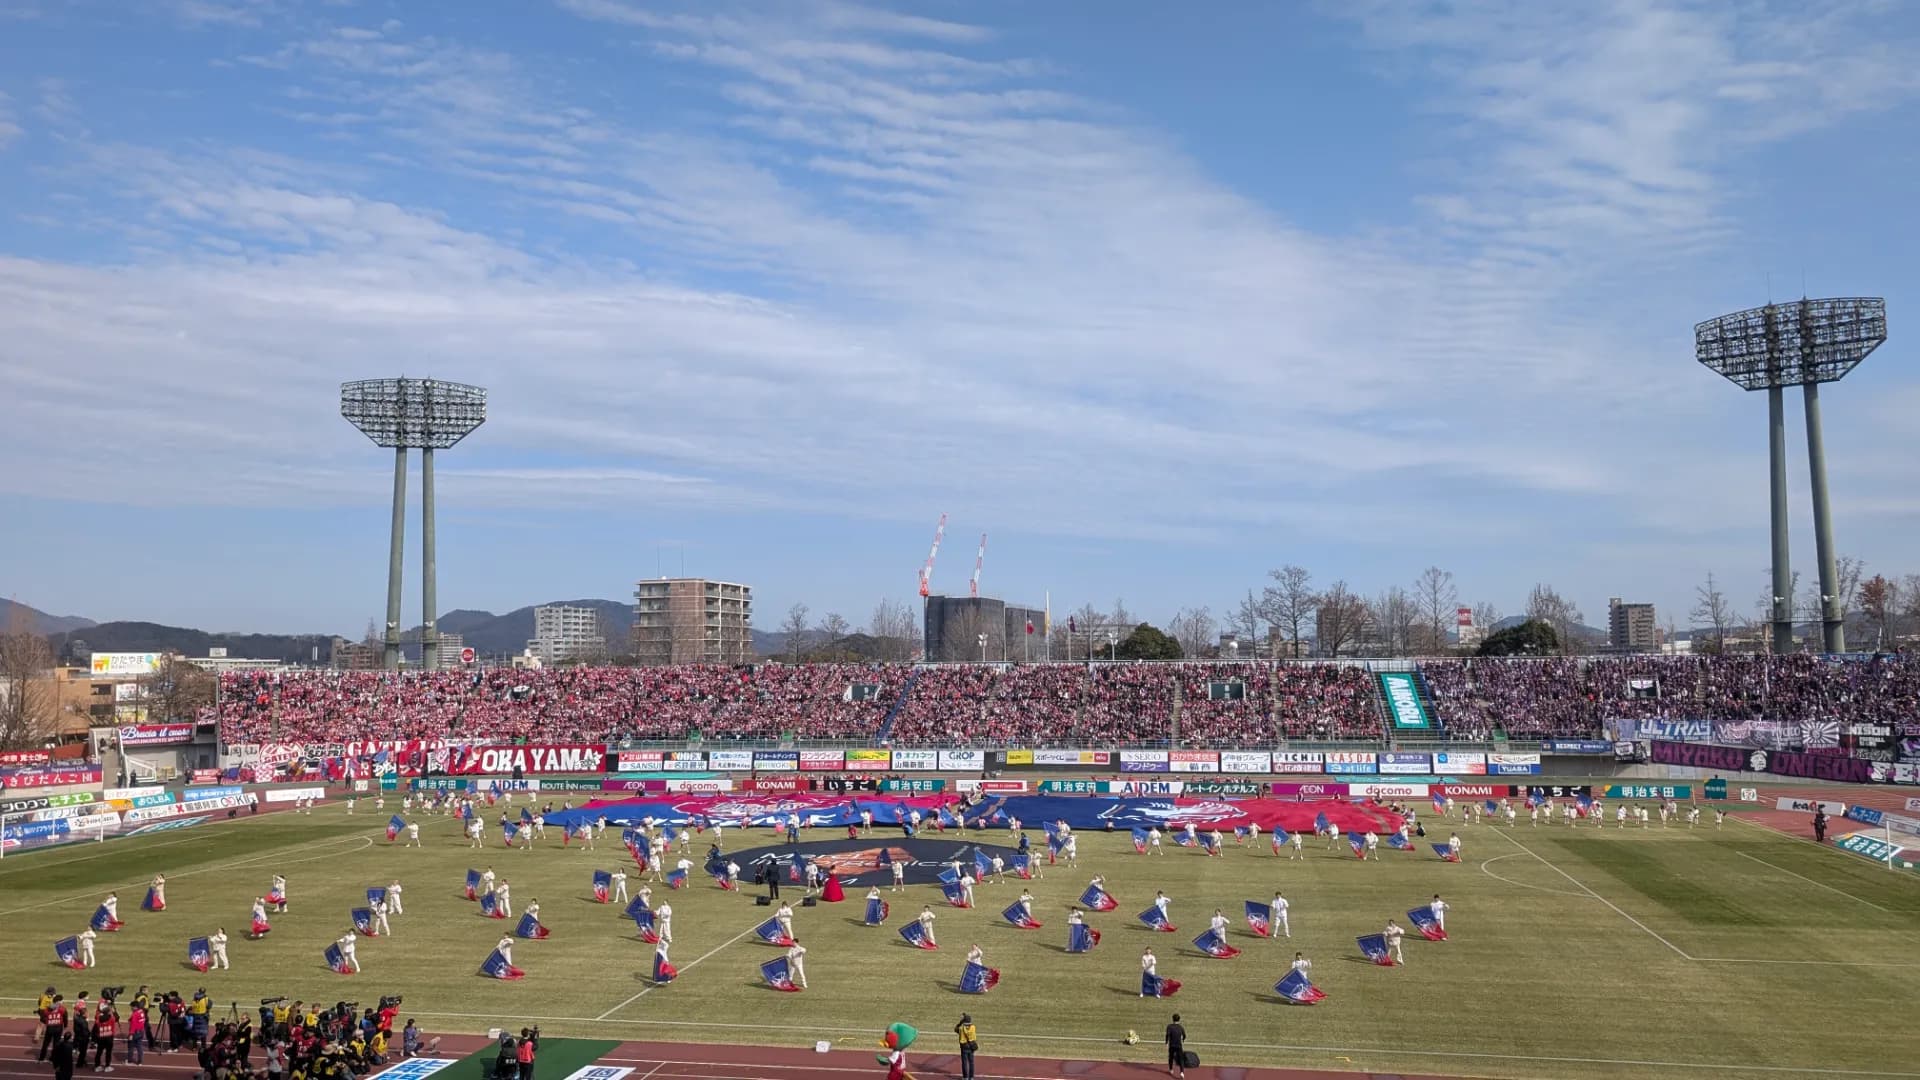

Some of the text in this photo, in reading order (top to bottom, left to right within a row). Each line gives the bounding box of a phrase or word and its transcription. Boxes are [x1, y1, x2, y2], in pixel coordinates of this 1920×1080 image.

[111, 655, 145, 665] かたやま
[1640, 719, 1712, 735] ULTRAS
[482, 748, 598, 773] OKAYAMA
[903, 752, 935, 760] オカネツ
[948, 751, 975, 760] GROP
[1330, 753, 1373, 763] YASDA
[1651, 743, 1744, 769] MIYAKO
[1772, 753, 1868, 783] UNISON
[418, 779, 456, 790] 明治安田
[679, 781, 719, 791] docomo
[756, 781, 796, 790] KONAMI
[829, 780, 870, 791] いちご
[889, 780, 933, 791] 明治安田
[1051, 782, 1097, 793] 明治安田
[1366, 785, 1413, 795] docomo
[1445, 786, 1493, 795] KONAMI
[1622, 786, 1675, 798] 明治安田
[48, 792, 94, 806] ニチエコ
[2, 798, 48, 812] シロクマ
